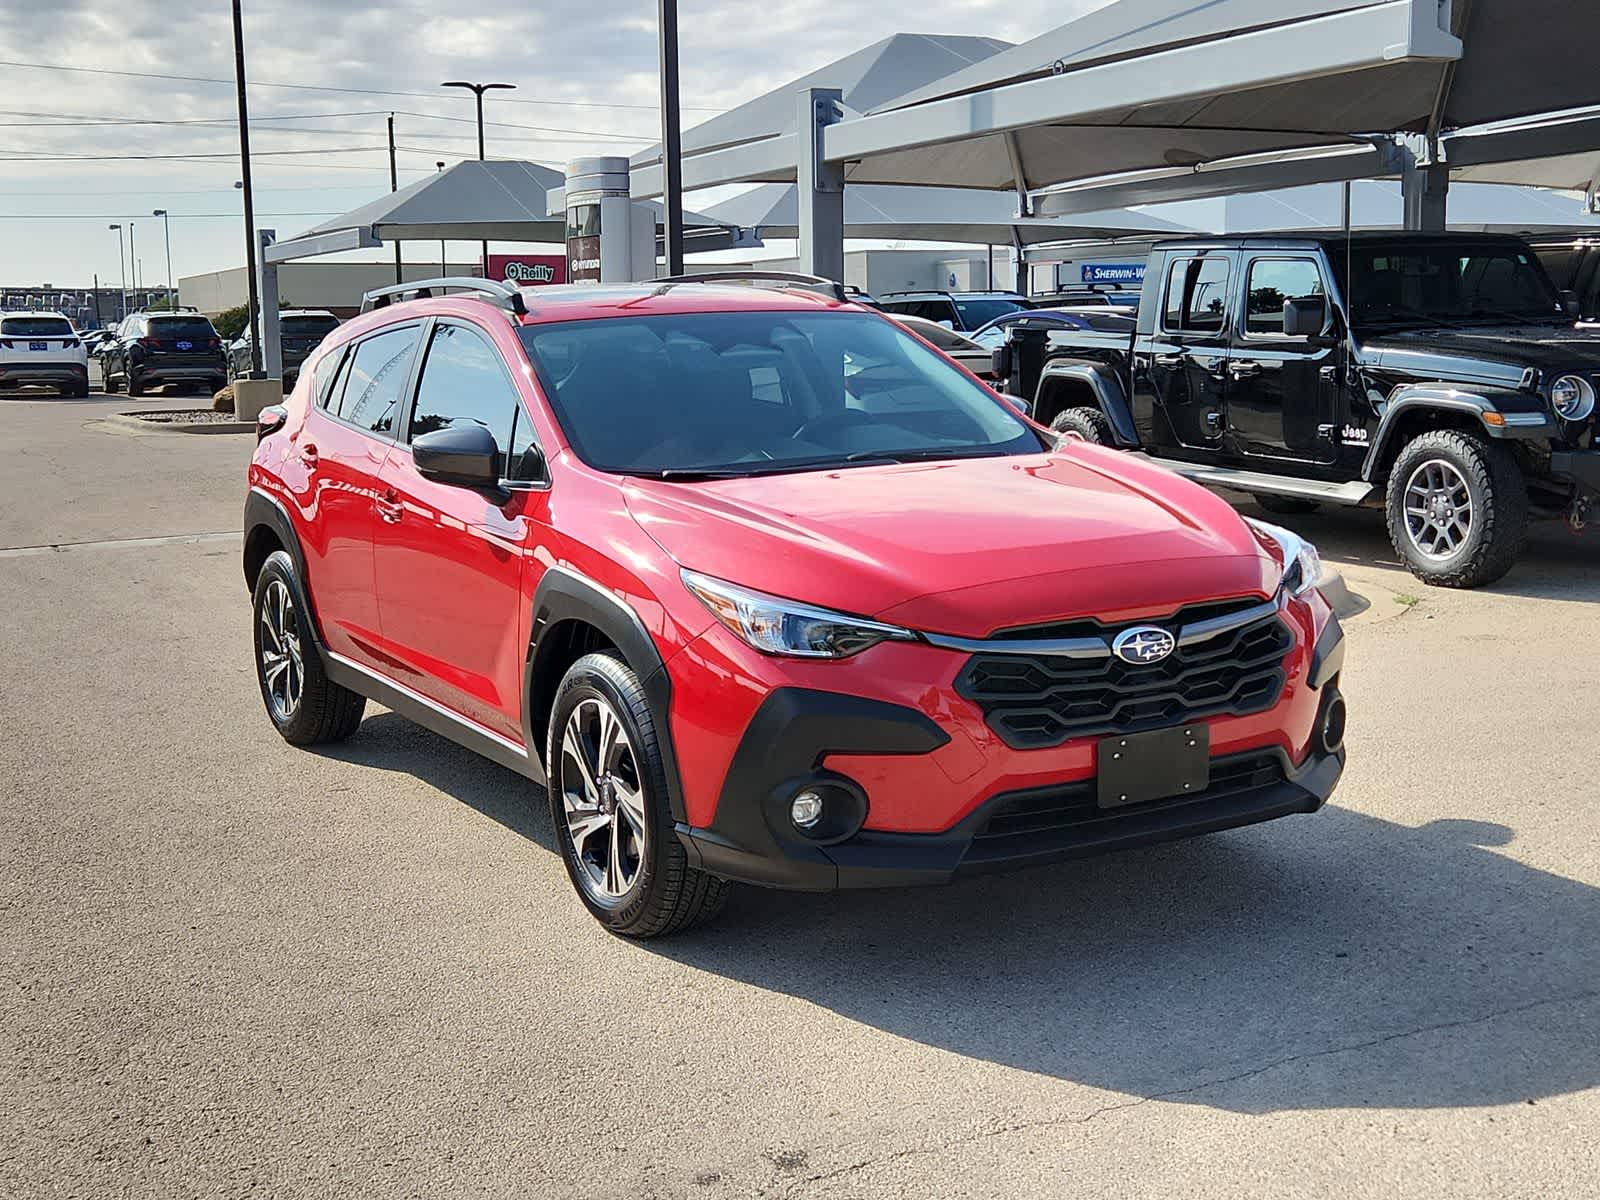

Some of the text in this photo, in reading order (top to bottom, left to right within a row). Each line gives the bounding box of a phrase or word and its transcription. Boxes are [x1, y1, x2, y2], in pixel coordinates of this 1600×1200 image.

[505, 262, 553, 281] O'Reilly
[1094, 267, 1145, 279] SHERWIN-W
[1342, 424, 1367, 440] Jeep
